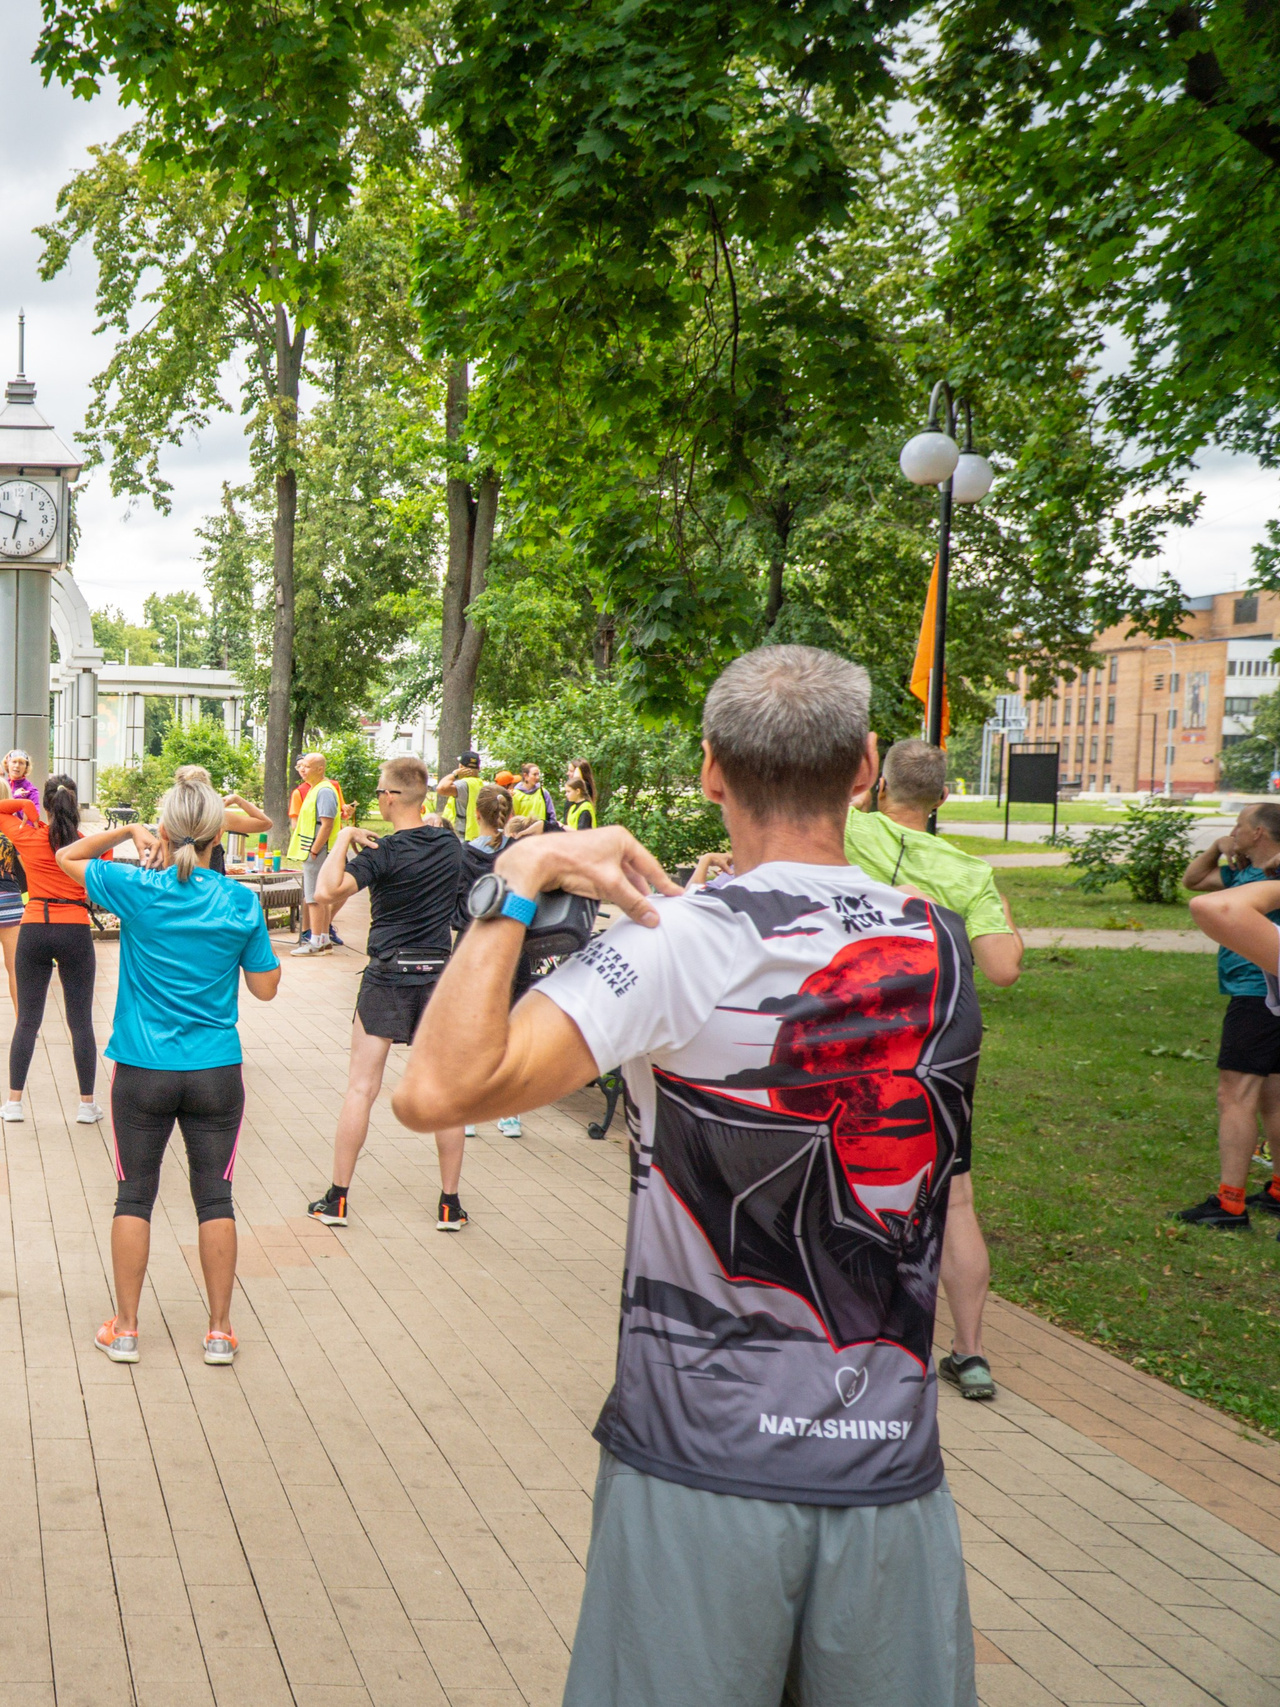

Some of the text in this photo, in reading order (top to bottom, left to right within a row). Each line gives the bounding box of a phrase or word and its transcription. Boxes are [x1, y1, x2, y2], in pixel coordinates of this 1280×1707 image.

[3, 492, 10, 500] 11
[15, 488, 24, 497] 12
[30, 492, 34, 501] 1
[39, 501, 45, 511] 2
[42, 514, 48, 524] 3
[39, 527, 44, 537] 4
[3, 537, 8, 546] 7
[16, 541, 21, 549] 6
[29, 538, 35, 547] 5
[606, 947, 638, 985] TRAIL
[596, 965, 625, 997] BIKE
